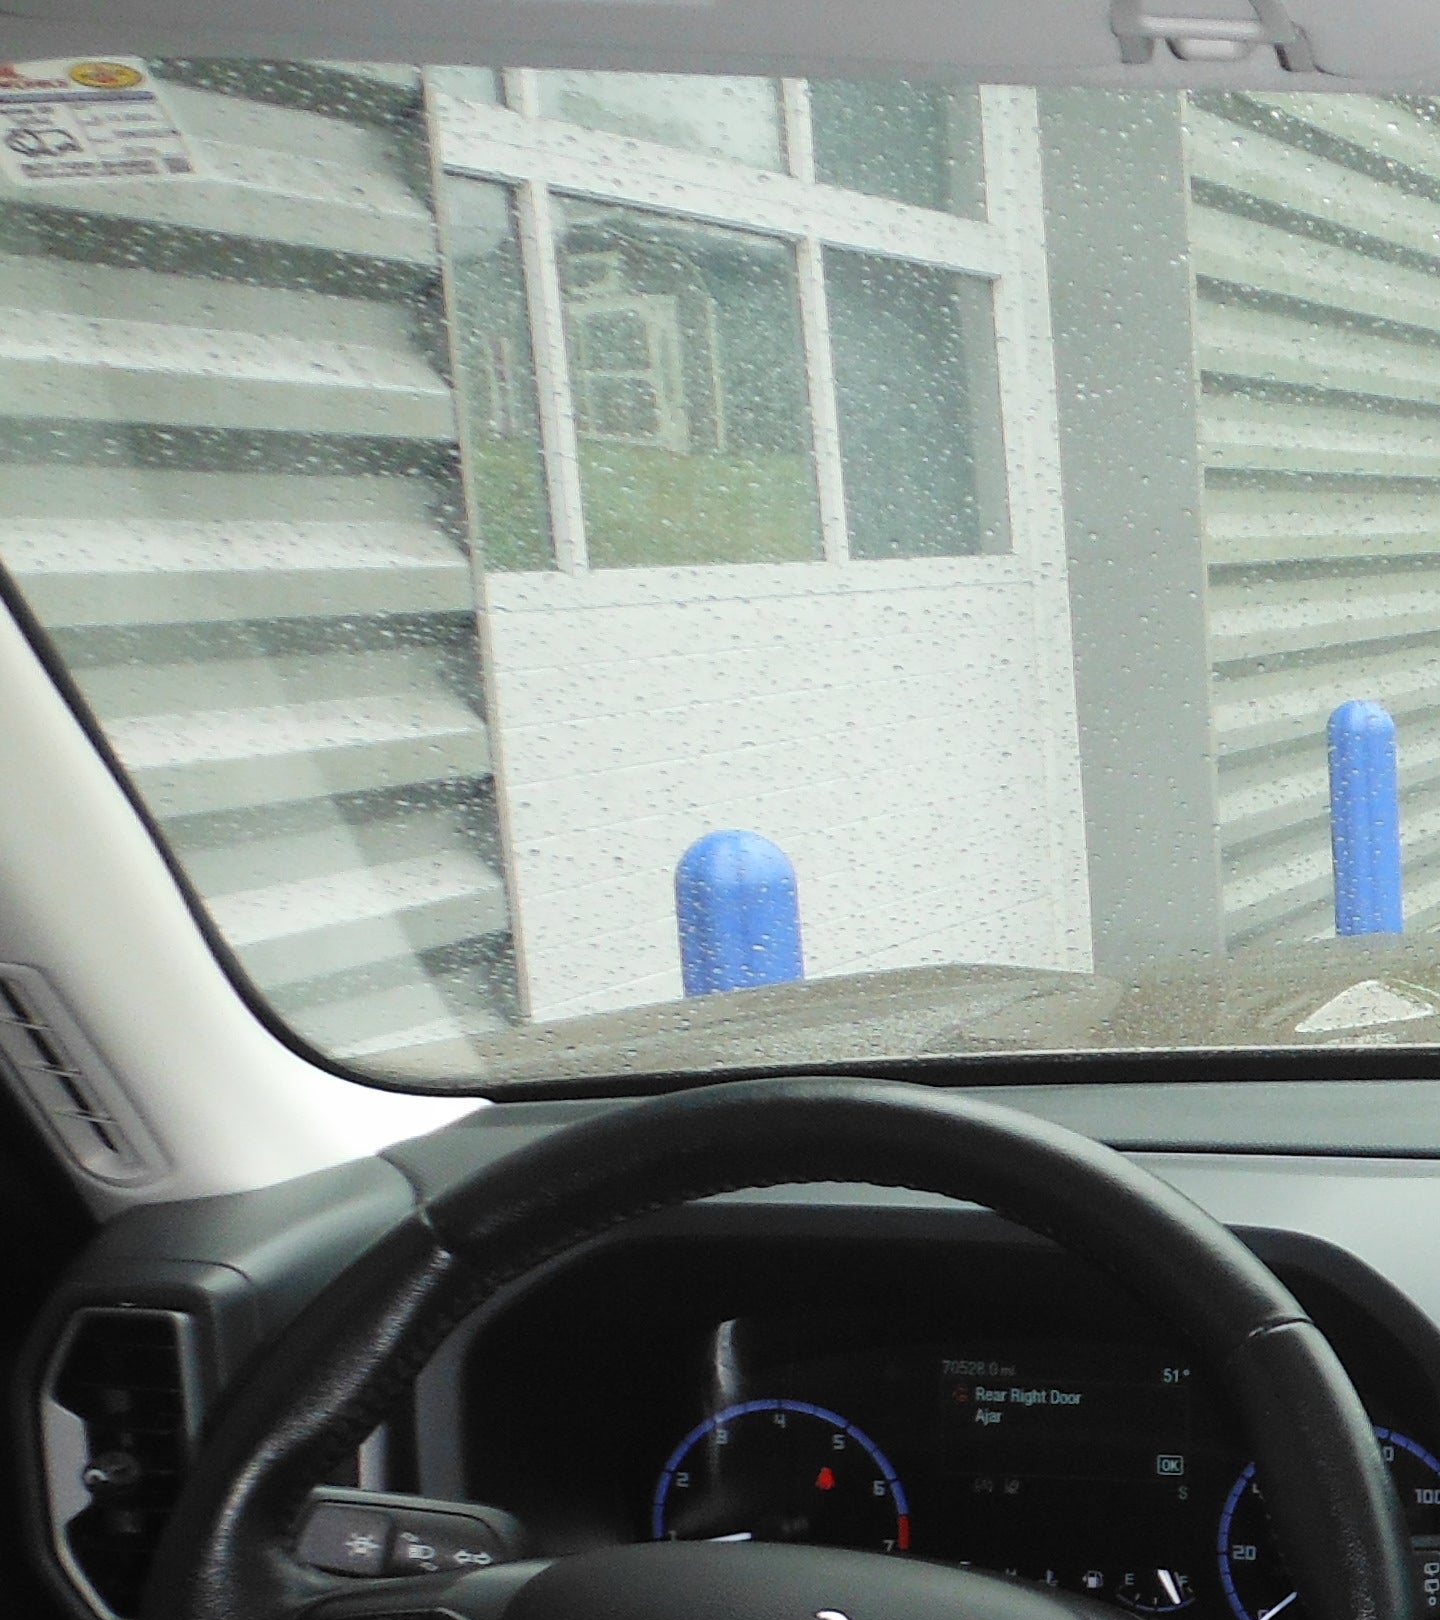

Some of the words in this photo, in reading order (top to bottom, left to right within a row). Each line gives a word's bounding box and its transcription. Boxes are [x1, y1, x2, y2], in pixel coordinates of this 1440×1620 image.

[975, 1386, 1008, 1402] Rear
[1010, 1388, 1047, 1407] Right
[1050, 1390, 1082, 1405] Door
[975, 1408, 1003, 1426] Ajar
[832, 1433, 847, 1451] 5
[1161, 1459, 1180, 1472] OK
[675, 1472, 690, 1488] 2
[872, 1480, 886, 1497] 6
[1231, 1544, 1257, 1561] 20
[1124, 1572, 1137, 1586] E
